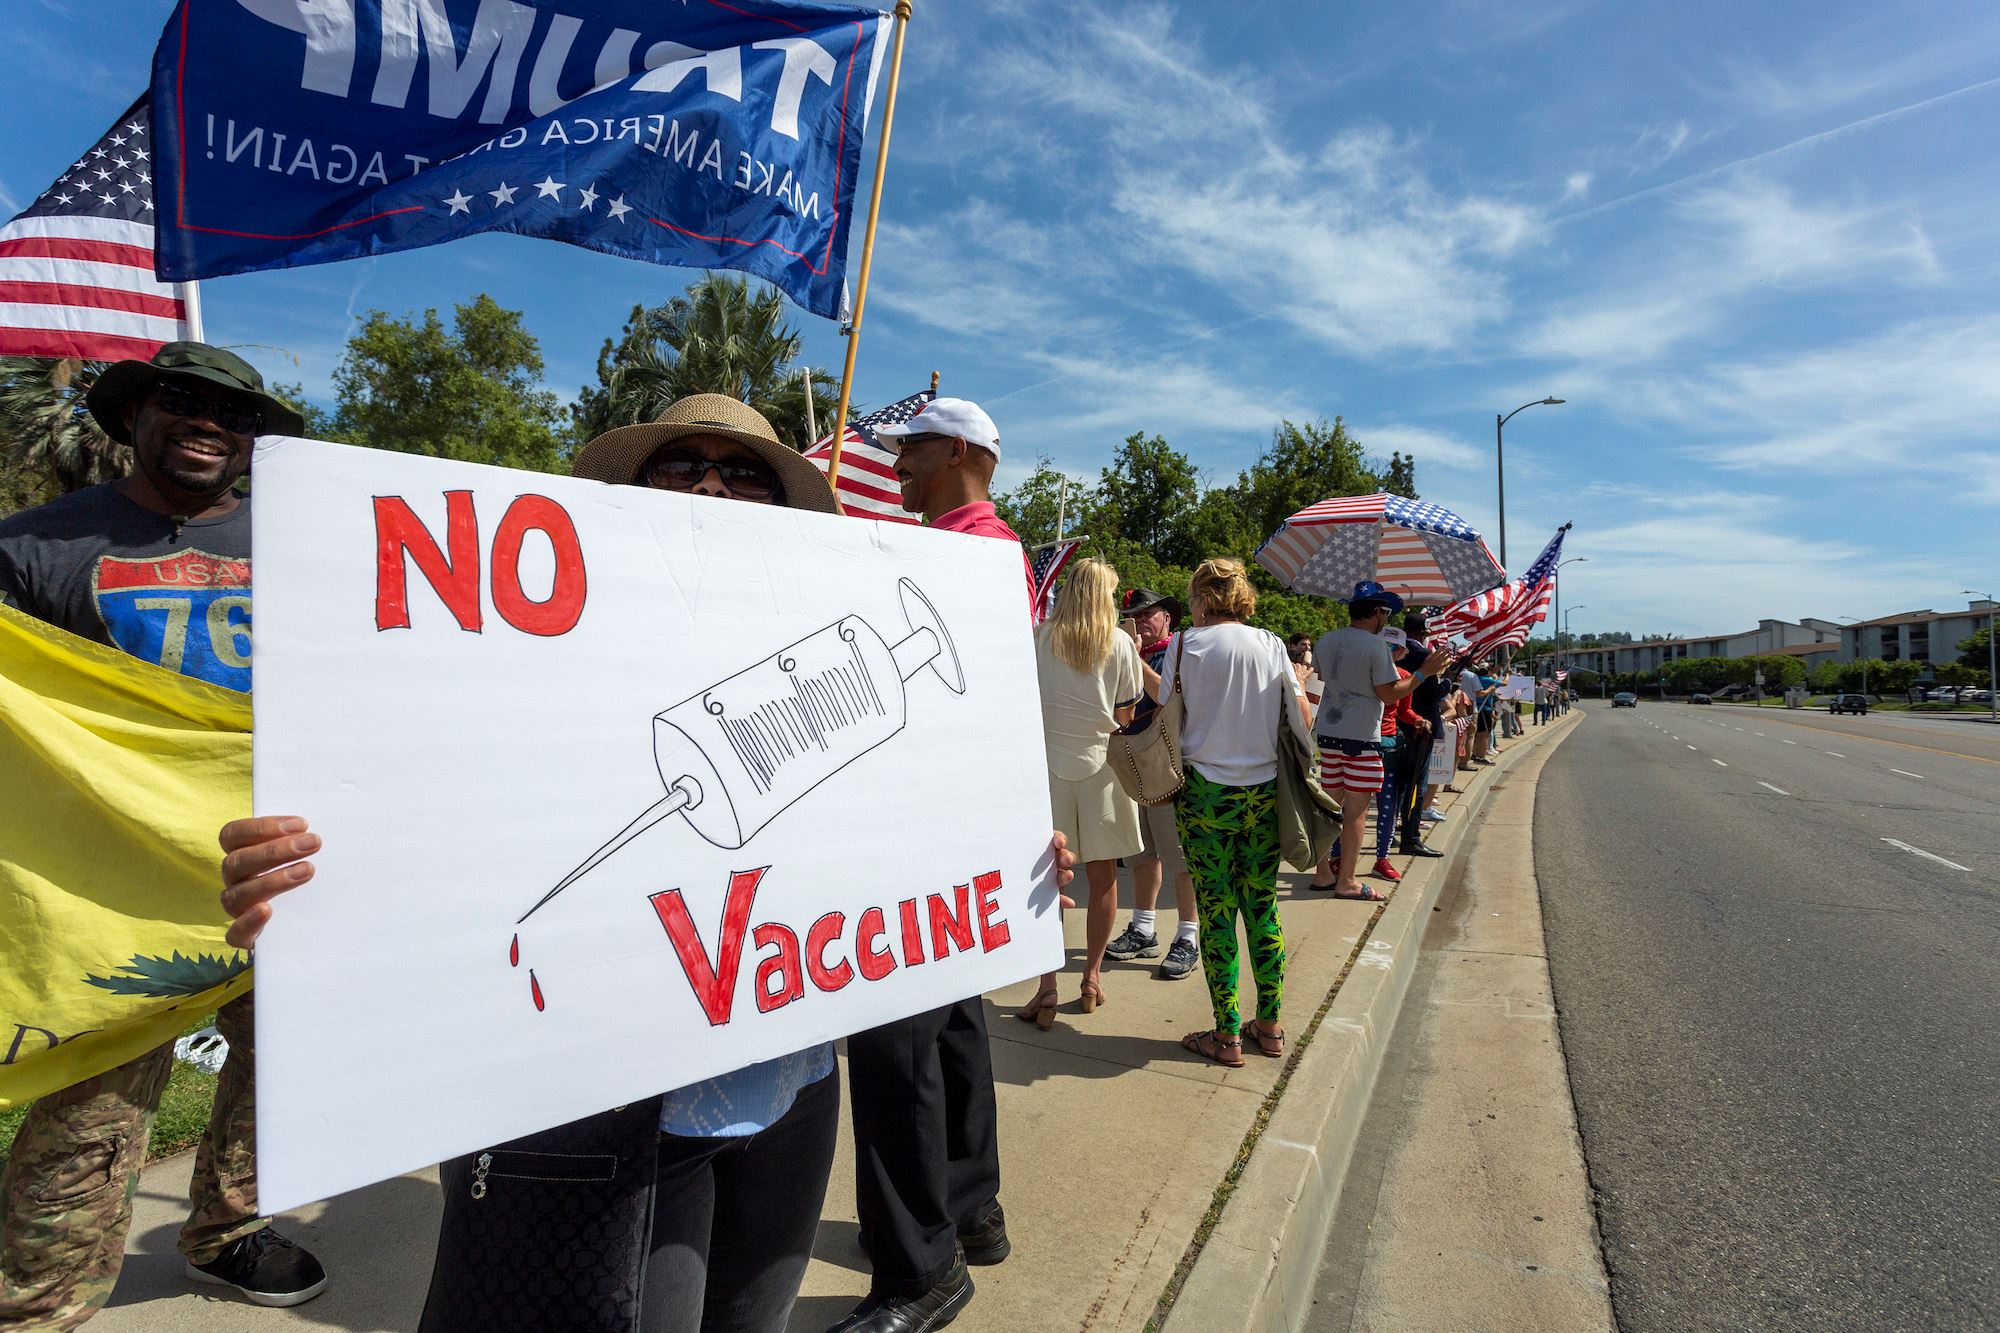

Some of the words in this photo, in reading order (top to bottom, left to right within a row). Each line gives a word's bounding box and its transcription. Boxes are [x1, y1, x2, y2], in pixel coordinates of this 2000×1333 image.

[153, 563, 240, 583] USA
[371, 490, 587, 636] NO
[134, 595, 253, 673] 76
[703, 692, 724, 716] 6
[778, 654, 796, 672] 6
[838, 621, 855, 642] 6
